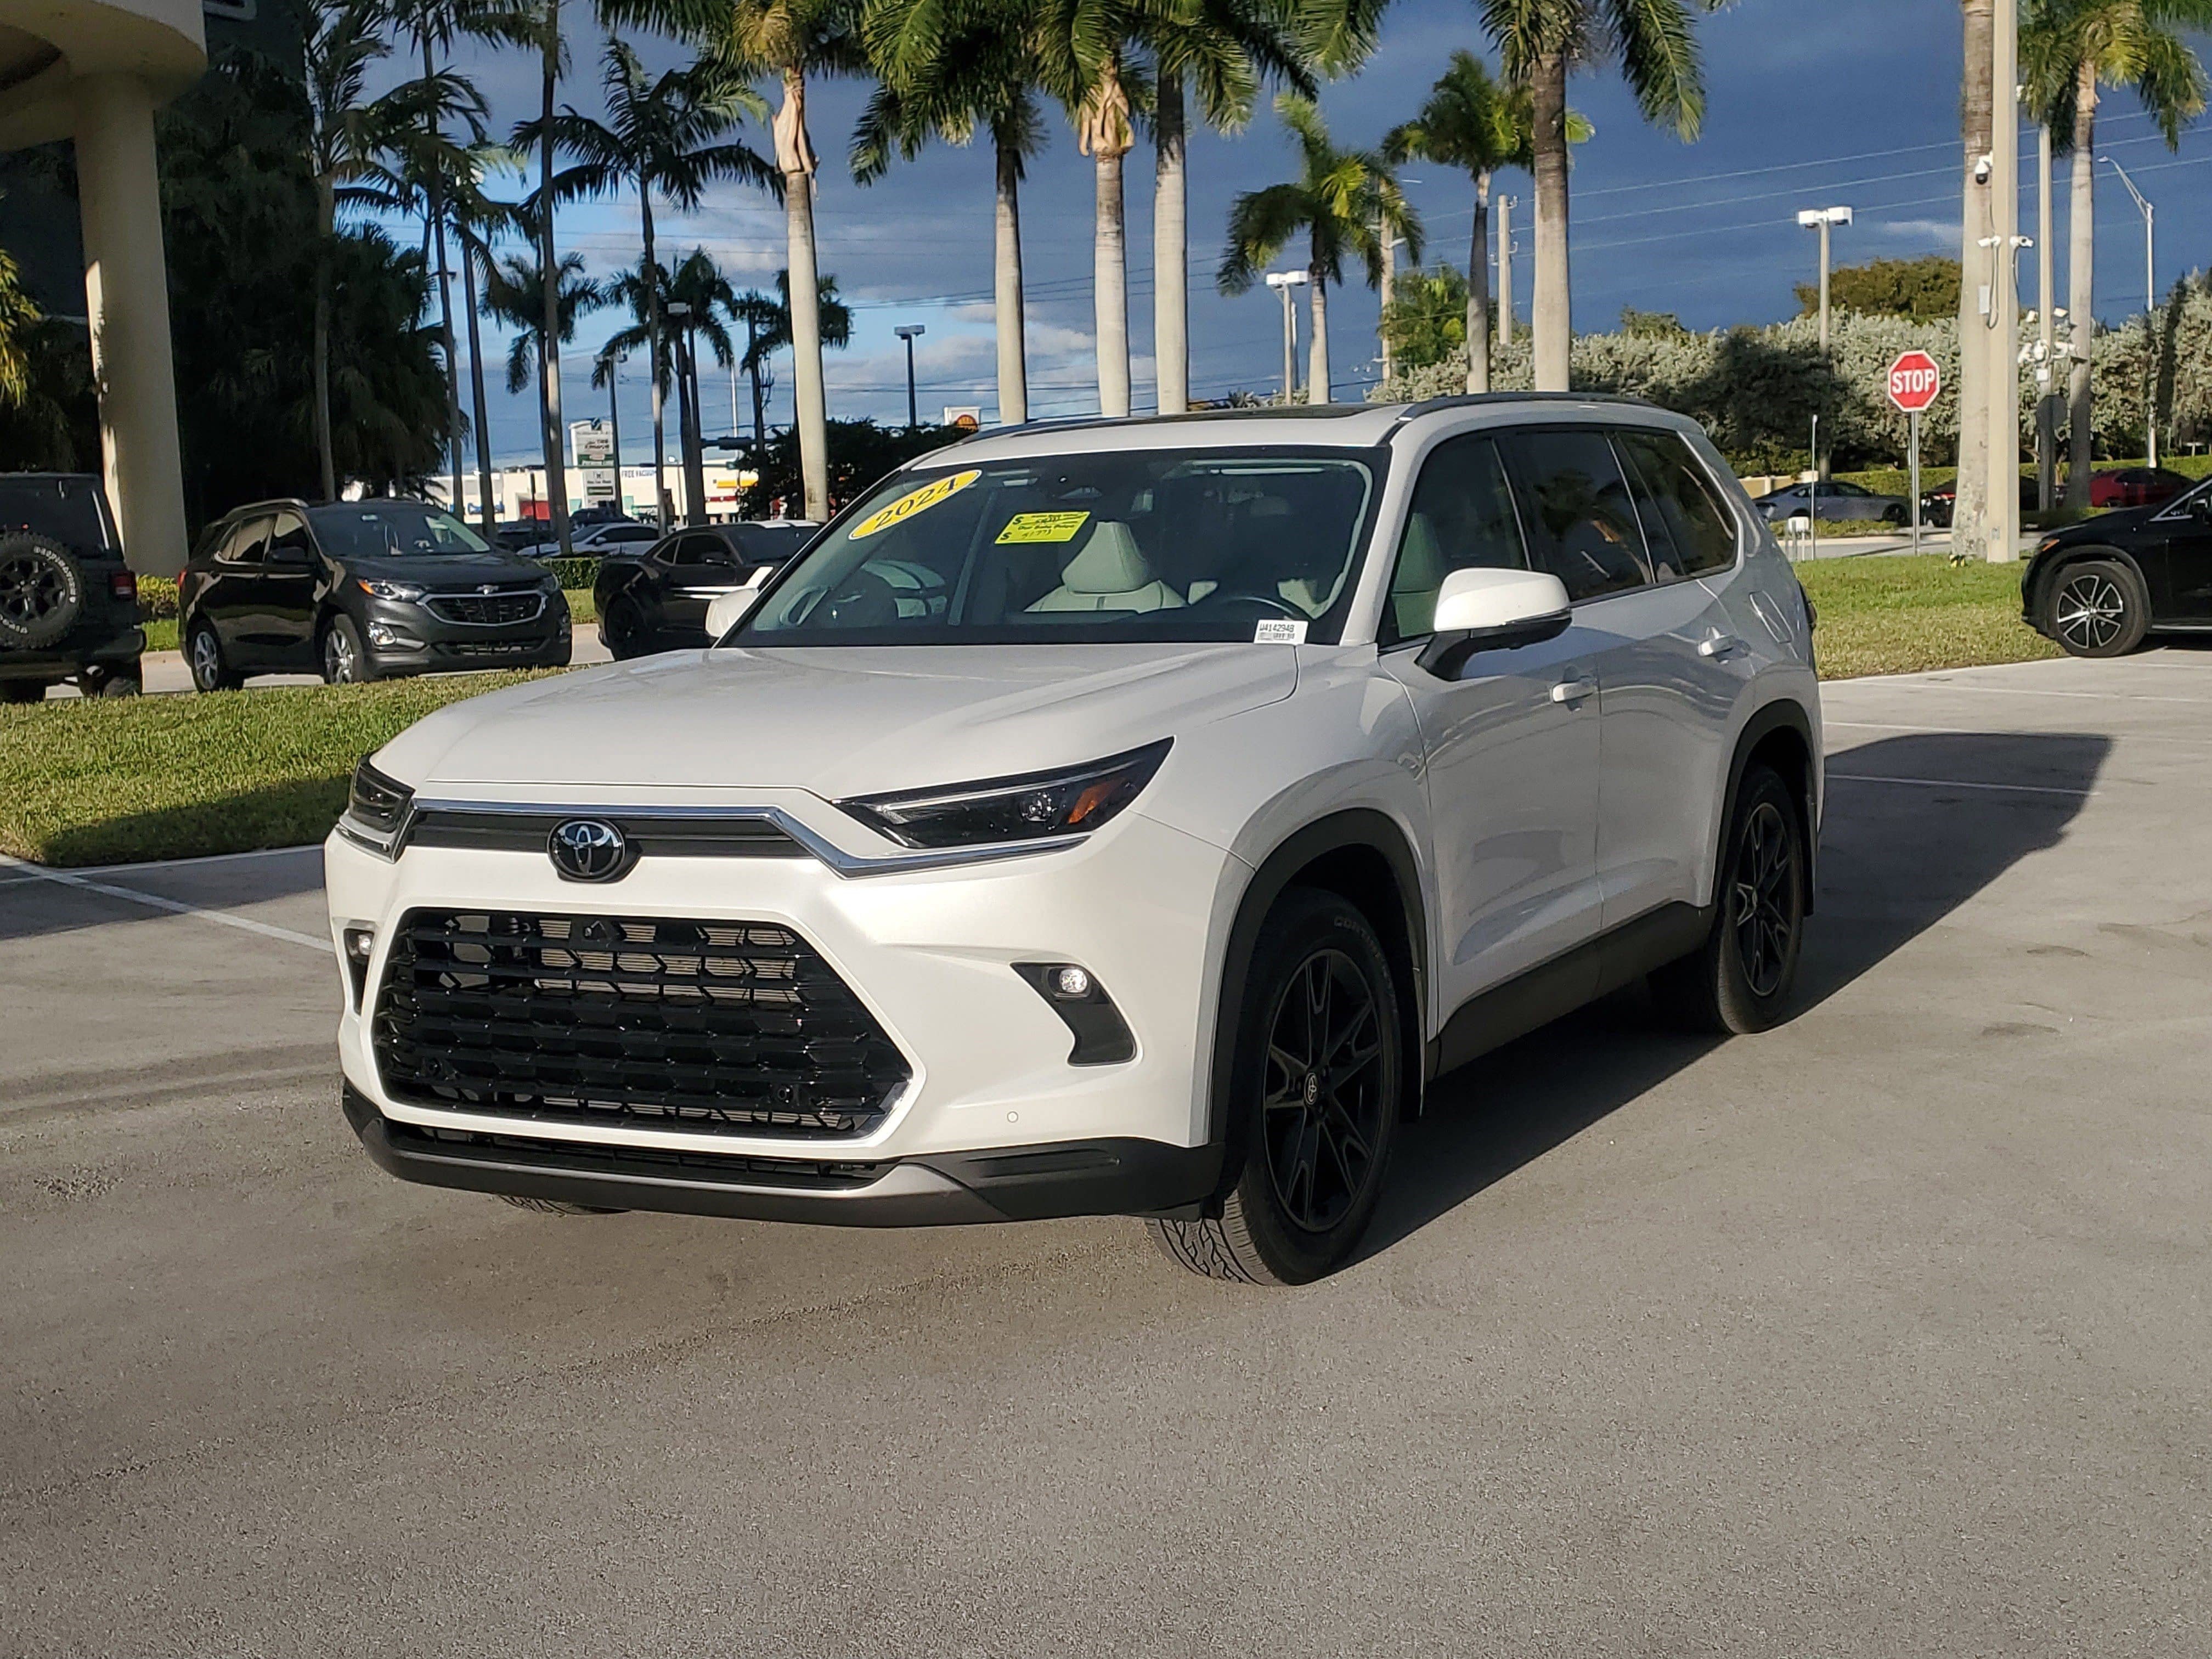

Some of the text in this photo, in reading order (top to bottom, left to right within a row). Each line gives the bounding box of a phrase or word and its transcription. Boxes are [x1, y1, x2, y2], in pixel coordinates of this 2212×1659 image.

[1892, 369, 1935, 394] STOP
[622, 470, 634, 478] FREE
[873, 477, 958, 530] 2024
